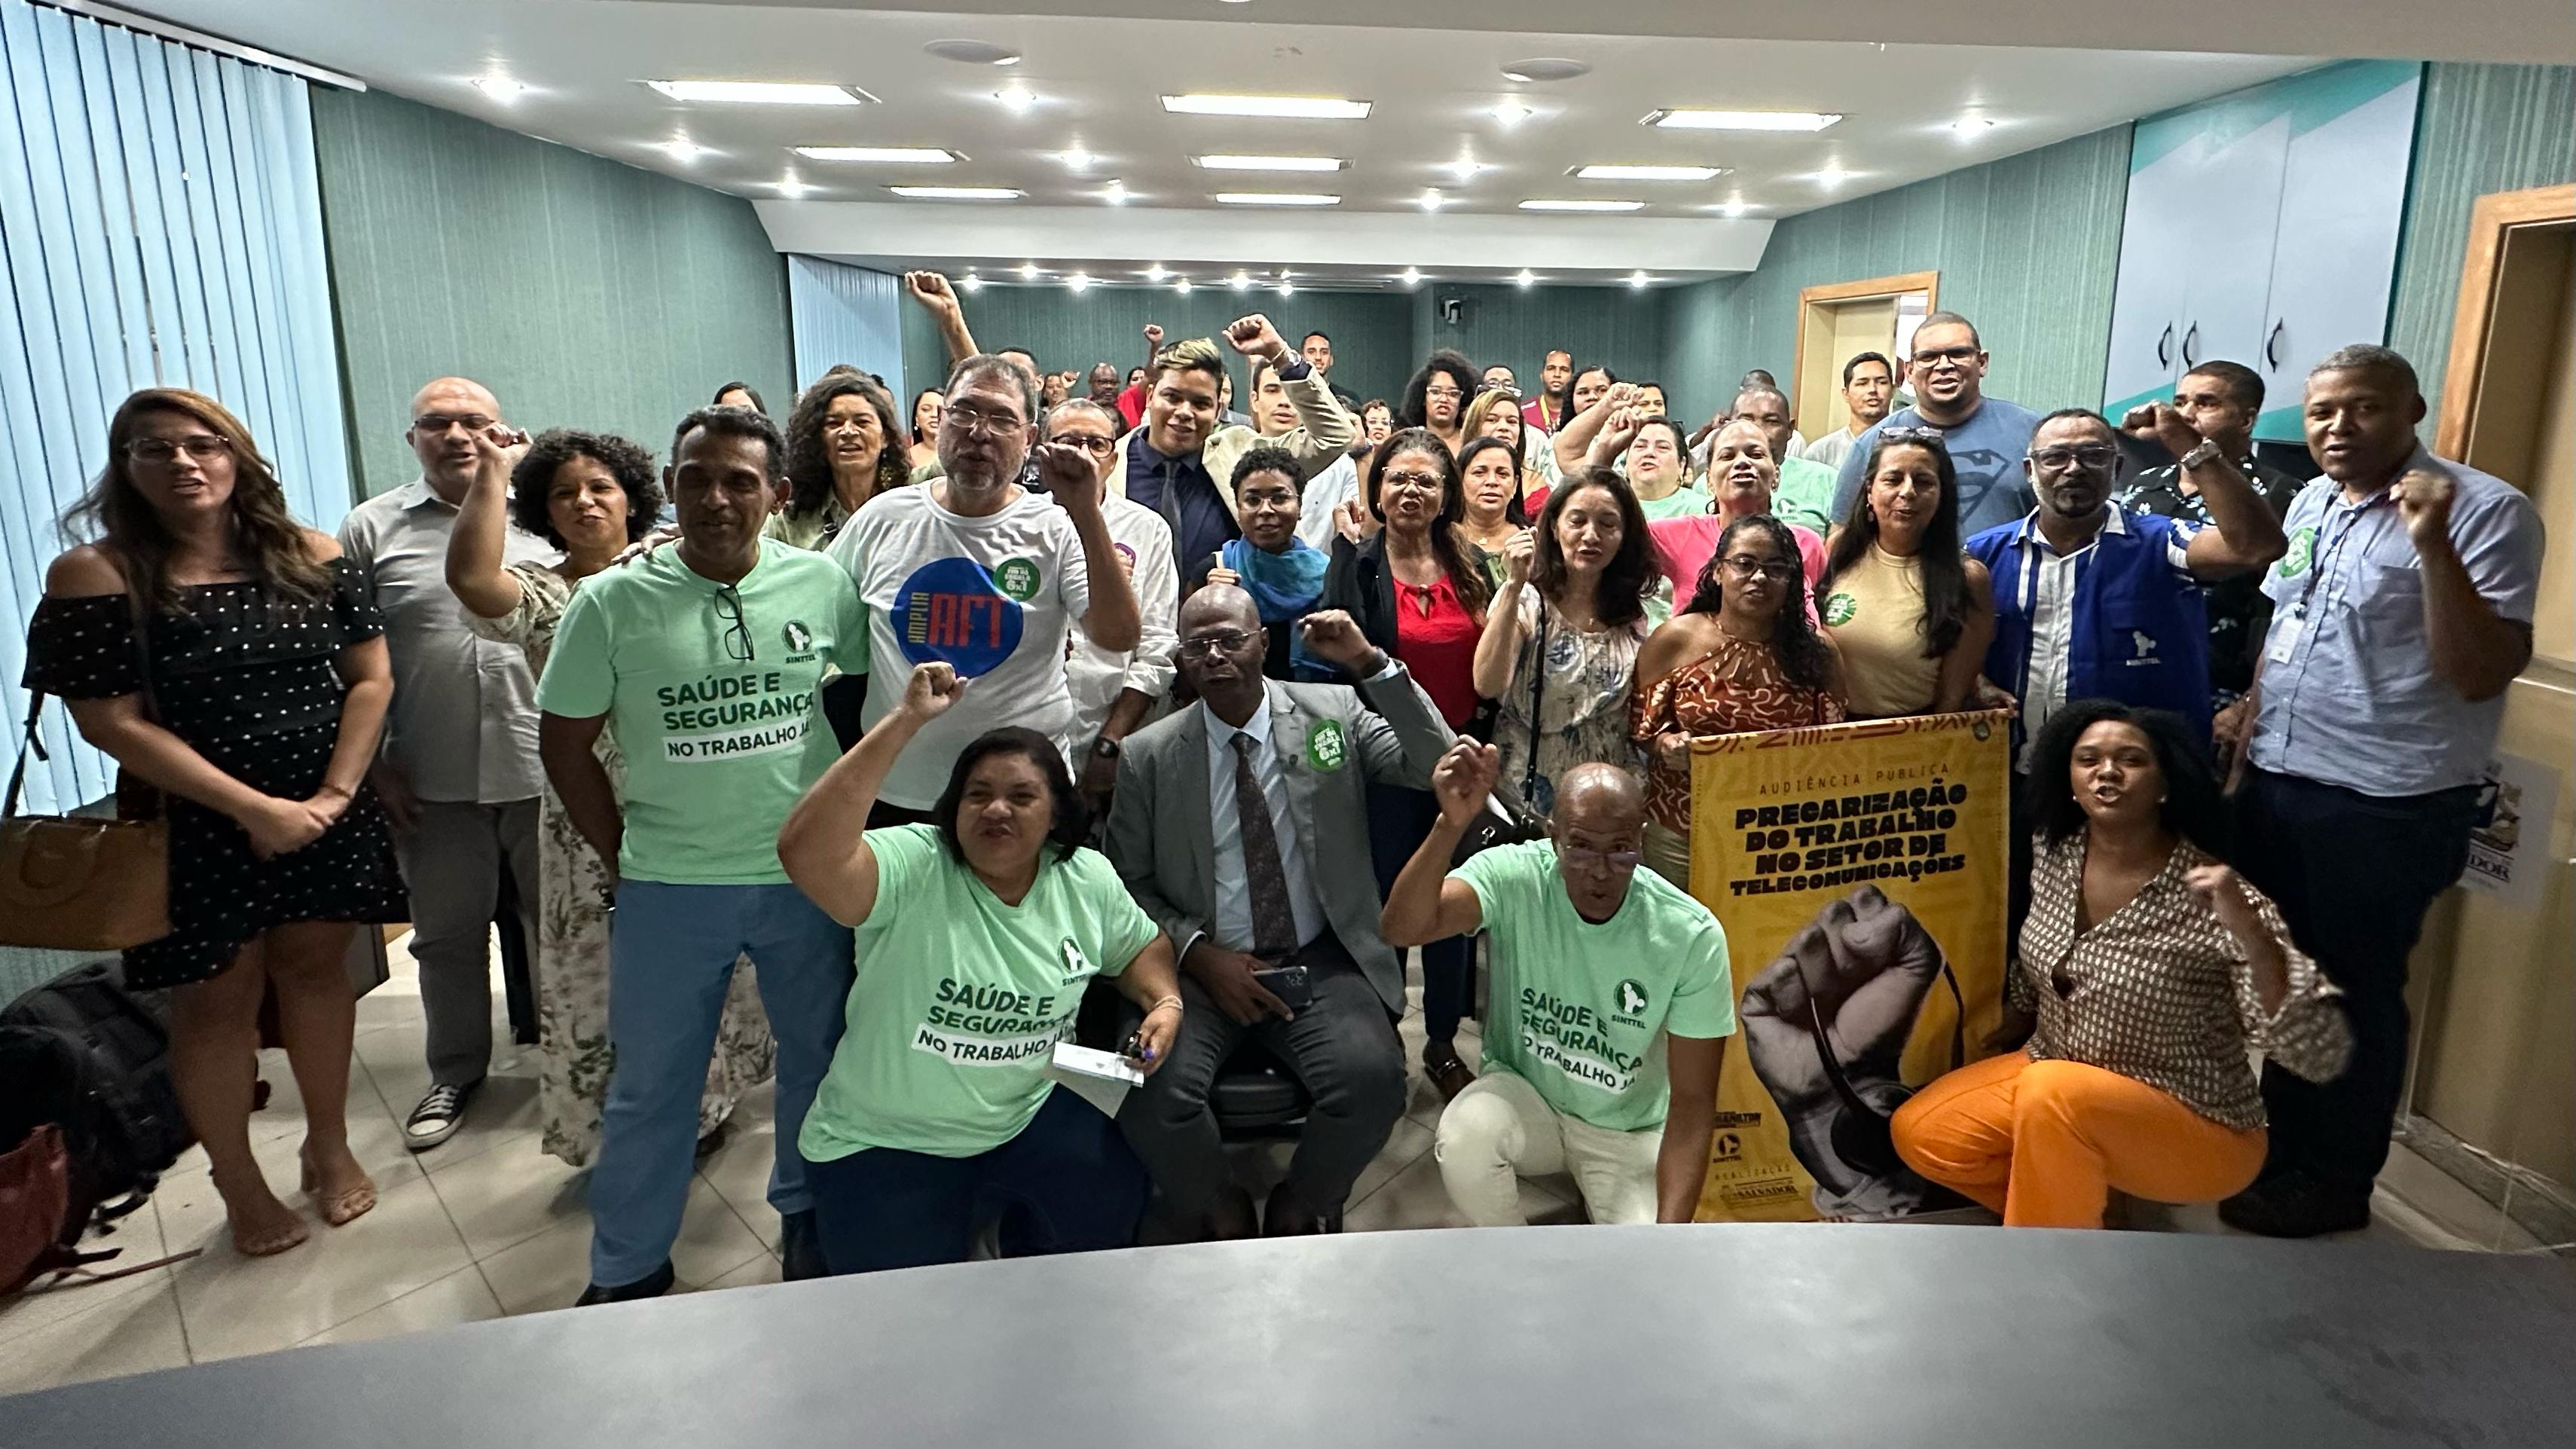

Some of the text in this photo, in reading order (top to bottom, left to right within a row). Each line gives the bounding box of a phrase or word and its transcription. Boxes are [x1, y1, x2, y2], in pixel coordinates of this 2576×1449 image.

[908, 592, 929, 643] AMPLIA
[928, 593, 1006, 648] AFT
[785, 654, 816, 665] SINTTEL
[657, 672, 781, 707] SAÚDE E
[663, 692, 814, 730] SEGURANÇA
[668, 742, 694, 757] NO
[698, 726, 796, 756] TRABALHO
[1759, 774, 1861, 795] AUDIÊNCIA
[1735, 778, 1967, 830] PRECARIZAÇÃO
[1746, 808, 1957, 852] DO TRABALHO
[1755, 833, 1946, 875] NO SETOR DE
[936, 978, 1055, 1016] SAÚDE E
[1521, 988, 1609, 1037] SAÚDE E
[1611, 1013, 1646, 1030] SINTTEL
[918, 1029, 947, 1053] NO
[952, 1038, 1047, 1061] TRABALHO
[1536, 1043, 1616, 1087] TRABALHO
